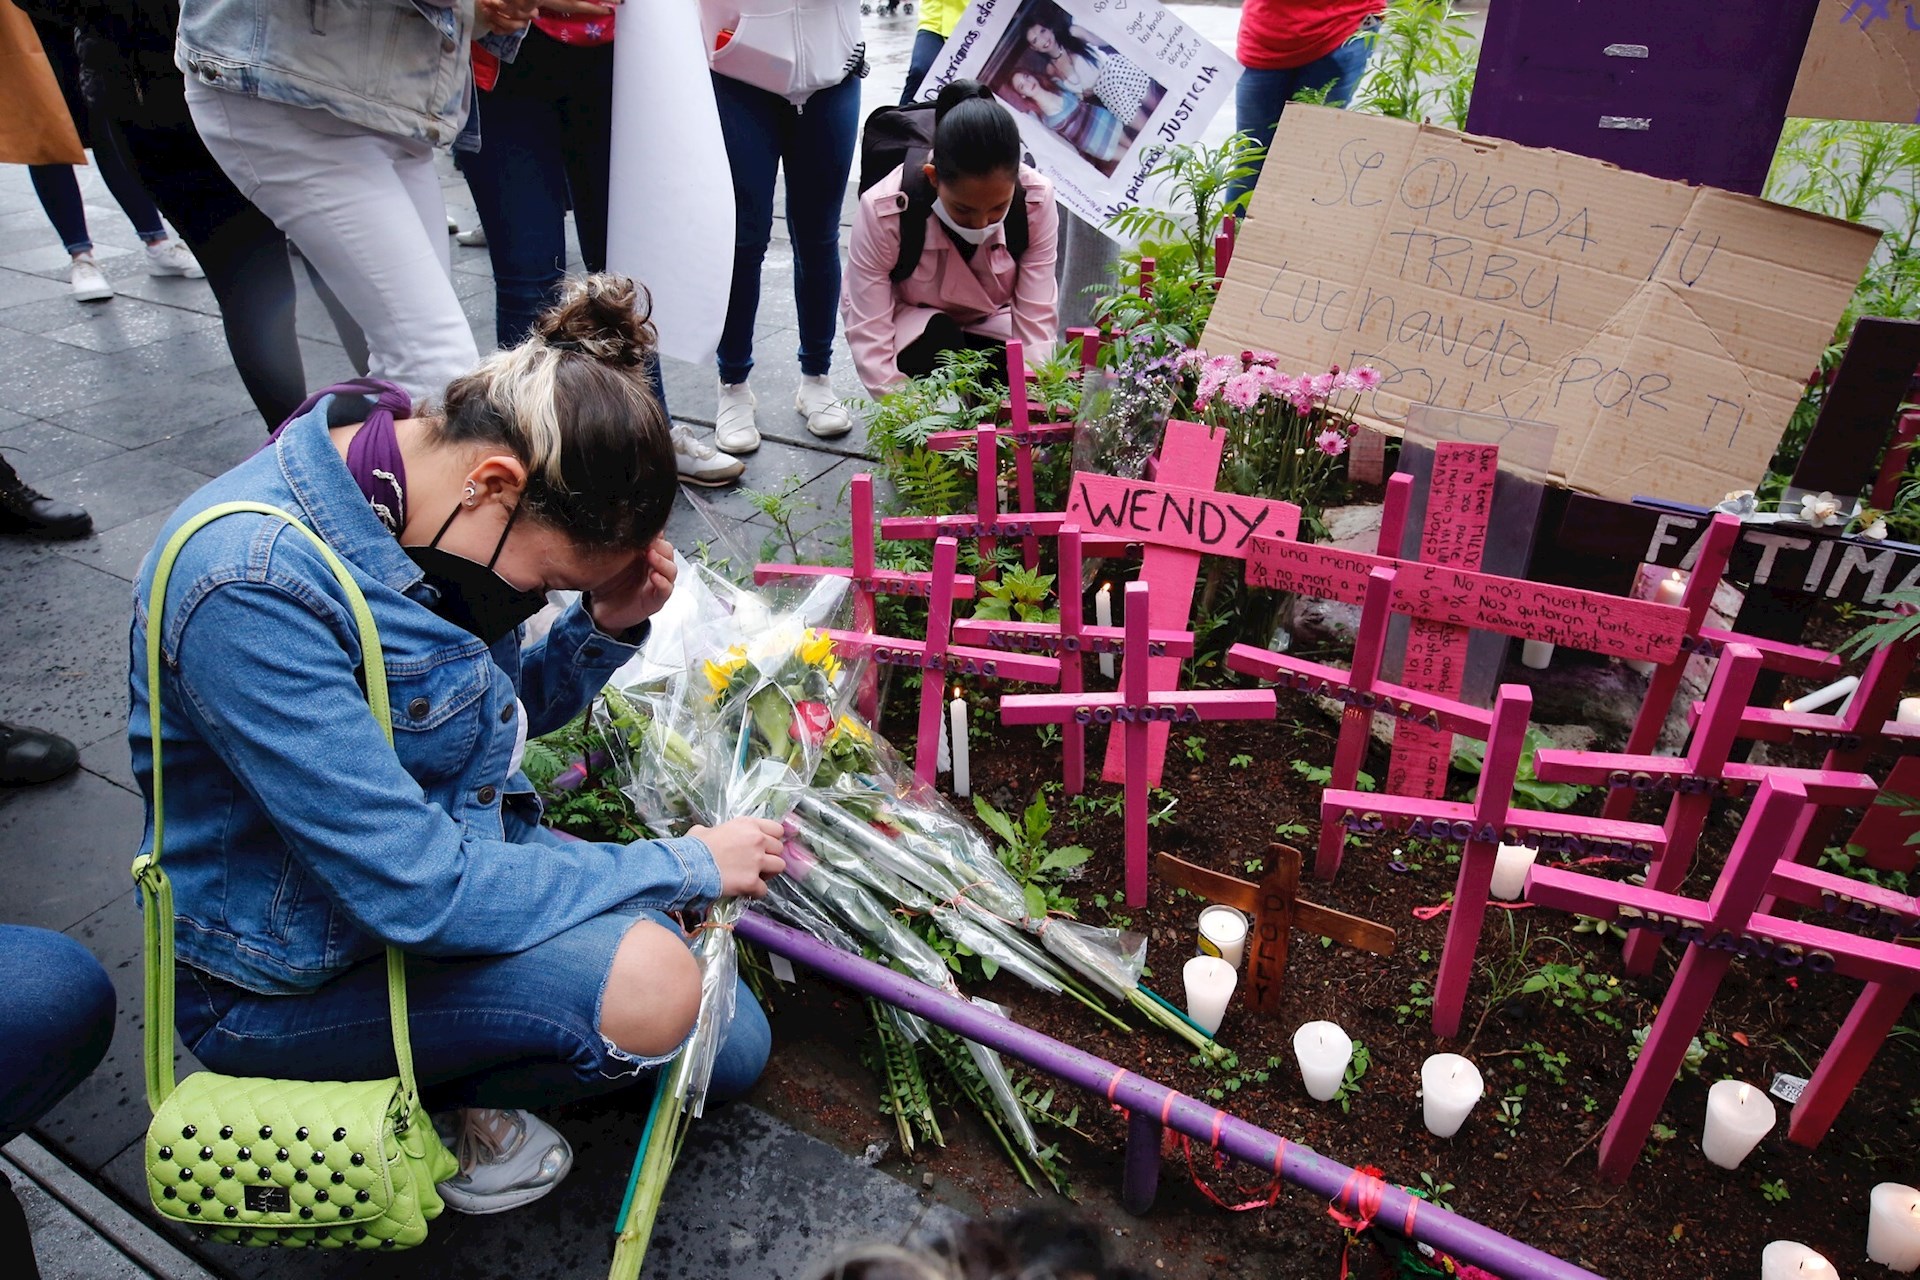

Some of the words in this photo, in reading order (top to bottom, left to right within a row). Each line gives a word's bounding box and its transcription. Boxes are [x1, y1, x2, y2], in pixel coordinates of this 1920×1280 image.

[1126, 11, 1146, 35] Sigue
[1137, 10, 1165, 44] bailando
[1104, 200, 1129, 220] No
[1125, 143, 1167, 203] pidiend
[1157, 64, 1219, 143] JUSTICIA
[1647, 222, 1721, 289] TU
[1554, 356, 1672, 418] POR
[1703, 392, 1752, 448] TI
[1479, 448, 1498, 473] Que
[1463, 472, 1474, 484] no
[1475, 483, 1493, 516] tener
[936, 521, 1036, 538] OAXACA
[1450, 524, 1467, 560] parte
[1252, 538, 1271, 555] Ni
[1281, 549, 1309, 564] una
[1320, 556, 1373, 577] menos
[1253, 562, 1268, 577] Yo
[1276, 568, 1293, 581] no
[1302, 573, 1334, 588] morí
[1341, 580, 1350, 589] a
[1453, 574, 1473, 591] No
[1484, 581, 1522, 601] más
[1533, 592, 1611, 617] muertas
[1479, 595, 1507, 612] Nos
[1518, 602, 1585, 627] quitaron
[1648, 632, 1676, 649] que
[986, 630, 1081, 652] NUEVO
[1093, 636, 1167, 657] LEN
[1634, 642, 1651, 657] el
[873, 646, 998, 677] CHIAPAS
[1437, 656, 1454, 693] cuando
[1074, 703, 1201, 725] SONORA
